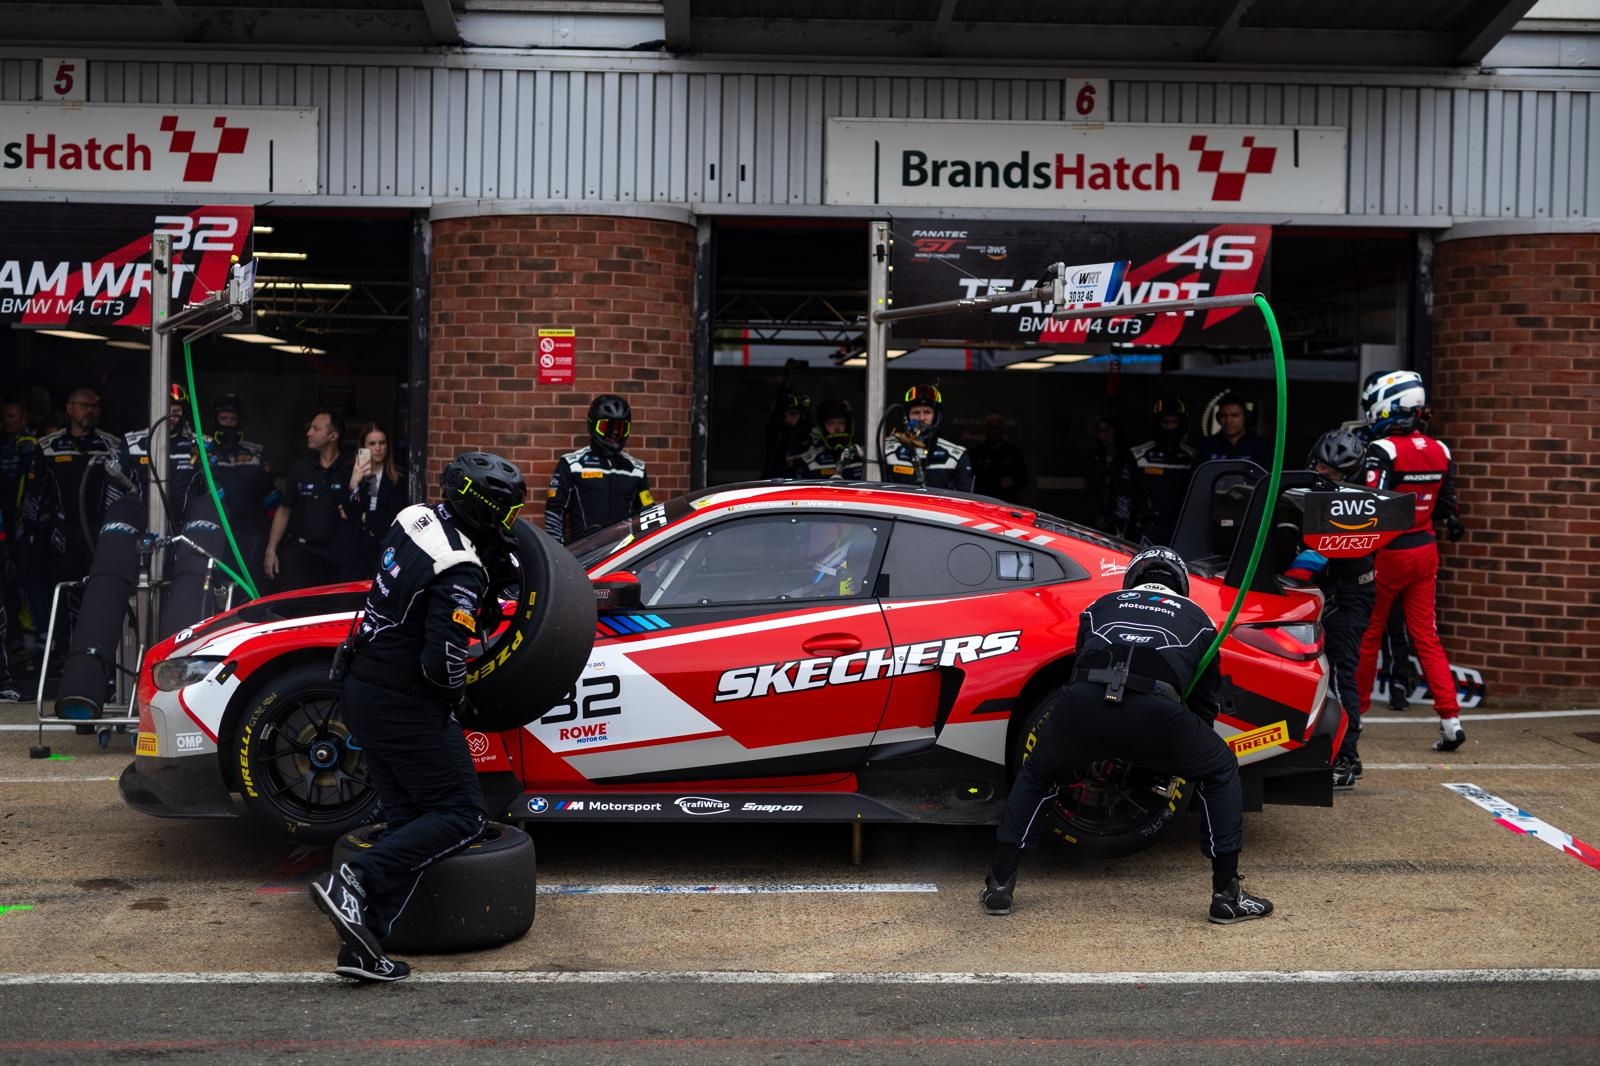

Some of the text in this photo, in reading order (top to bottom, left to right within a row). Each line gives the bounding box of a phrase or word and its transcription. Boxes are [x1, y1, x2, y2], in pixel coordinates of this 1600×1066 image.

[54, 64, 75, 95] 5
[1076, 84, 1097, 116] 6
[3, 133, 152, 171] sHatch
[902, 150, 1181, 192] BrandsHatch
[154, 215, 238, 251] 32
[912, 230, 968, 238] FANATEC
[987, 246, 1007, 254] aws
[1166, 235, 1256, 270] 46
[1078, 271, 1102, 285] WRT
[960, 278, 1083, 314] TEA
[1, 298, 125, 316] BMW M4 GT3
[1019, 317, 1142, 335] BMW M4 GT3
[1330, 499, 1376, 516] aws
[1318, 534, 1380, 551] WRT
[1119, 602, 1175, 618] Motorsport
[714, 630, 1022, 702] SKECHERS
[560, 723, 607, 740] ROWE
[1228, 727, 1282, 753] PIRELLI
[176, 736, 203, 748] OMP
[240, 725, 258, 797] PIRELLI
[589, 801, 662, 812] Motorsport
[680, 801, 730, 810] GrafiWrap
[741, 802, 803, 813] Snap-on
